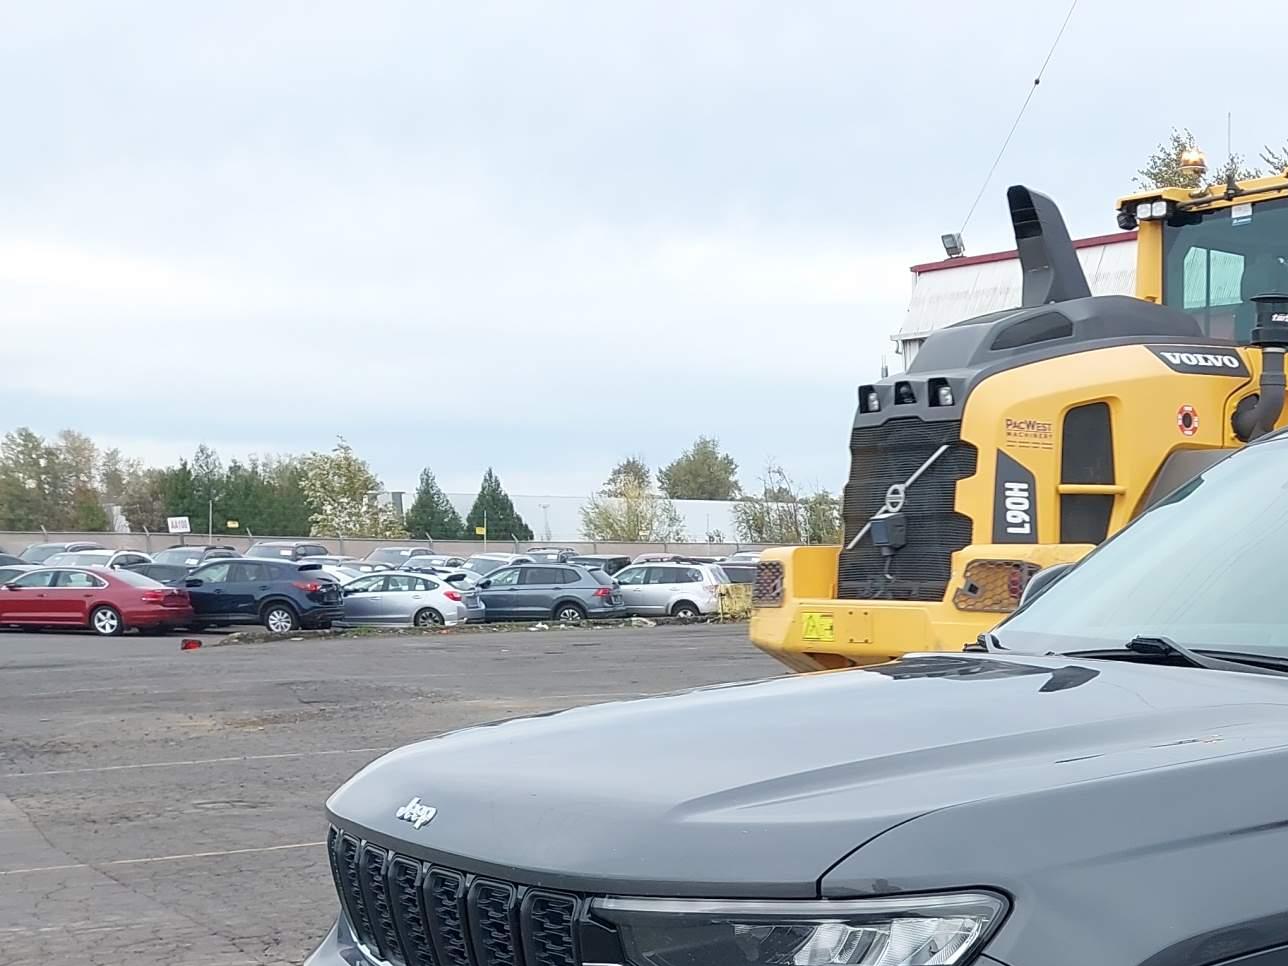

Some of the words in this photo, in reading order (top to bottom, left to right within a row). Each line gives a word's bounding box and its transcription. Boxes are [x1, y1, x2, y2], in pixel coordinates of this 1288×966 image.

[1160, 352, 1240, 368] VOLVO
[1004, 482, 1031, 534] L90H
[396, 797, 437, 830] Jeep
